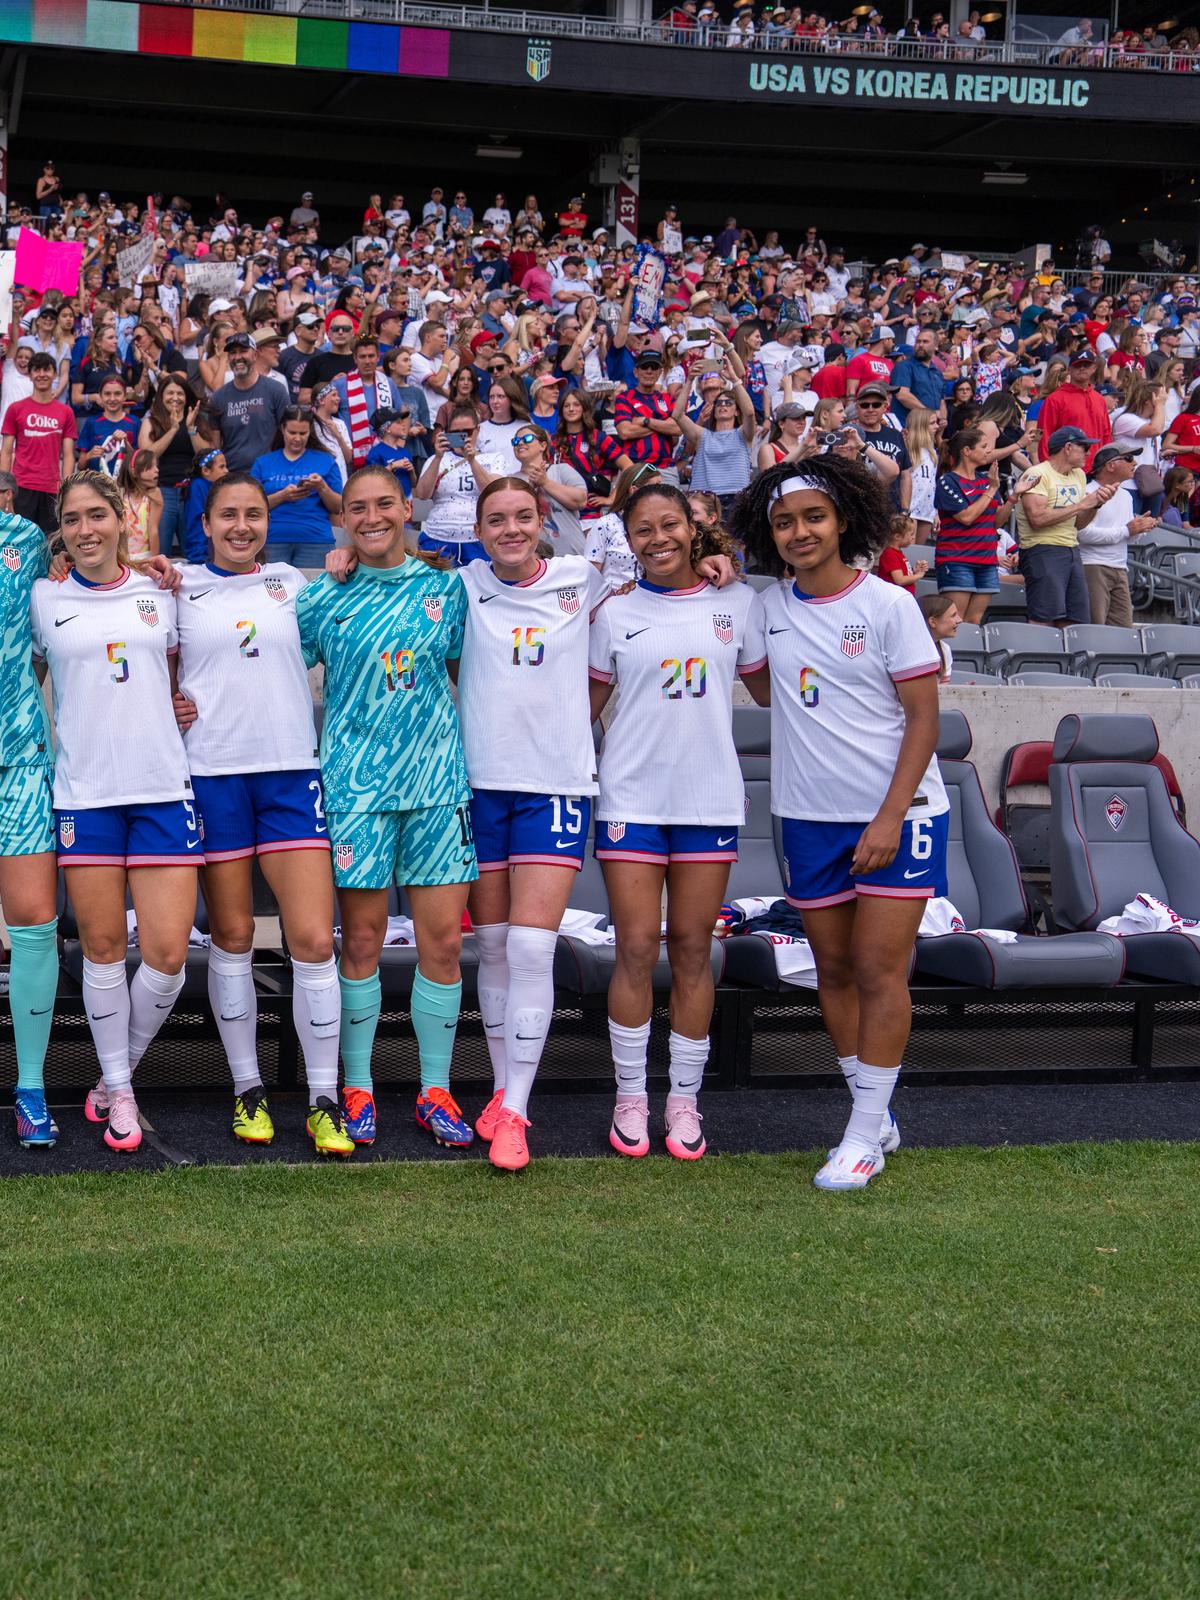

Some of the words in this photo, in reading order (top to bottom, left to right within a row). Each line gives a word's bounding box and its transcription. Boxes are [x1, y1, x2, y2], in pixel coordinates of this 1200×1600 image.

[749, 63, 806, 93] USA
[814, 67, 849, 95] VS
[856, 69, 949, 100] KOREA
[955, 74, 1090, 107] REPUBLIC
[621, 195, 635, 223] 131
[872, 361, 889, 374] USA
[227, 398, 264, 409] RAPINOE
[227, 407, 248, 417] BIRD
[27, 413, 59, 429] Coke
[877, 440, 901, 456] NAVY
[921, 465, 929, 478] 11
[458, 475, 473, 492] 15
[3, 548, 19, 558] USA
[560, 591, 576, 600] USA
[139, 605, 155, 613] USA
[425, 600, 440, 609] USA
[715, 620, 731, 629] USA
[236, 620, 260, 658] 2
[844, 632, 864, 642] USA
[511, 627, 545, 666] 15
[106, 642, 130, 684] 5
[380, 649, 417, 692] 18
[661, 657, 707, 700] 20
[800, 668, 819, 708] 6
[308, 780, 325, 818] 2
[549, 796, 582, 834] 15
[911, 819, 933, 860] 6
[337, 846, 352, 856] USA
